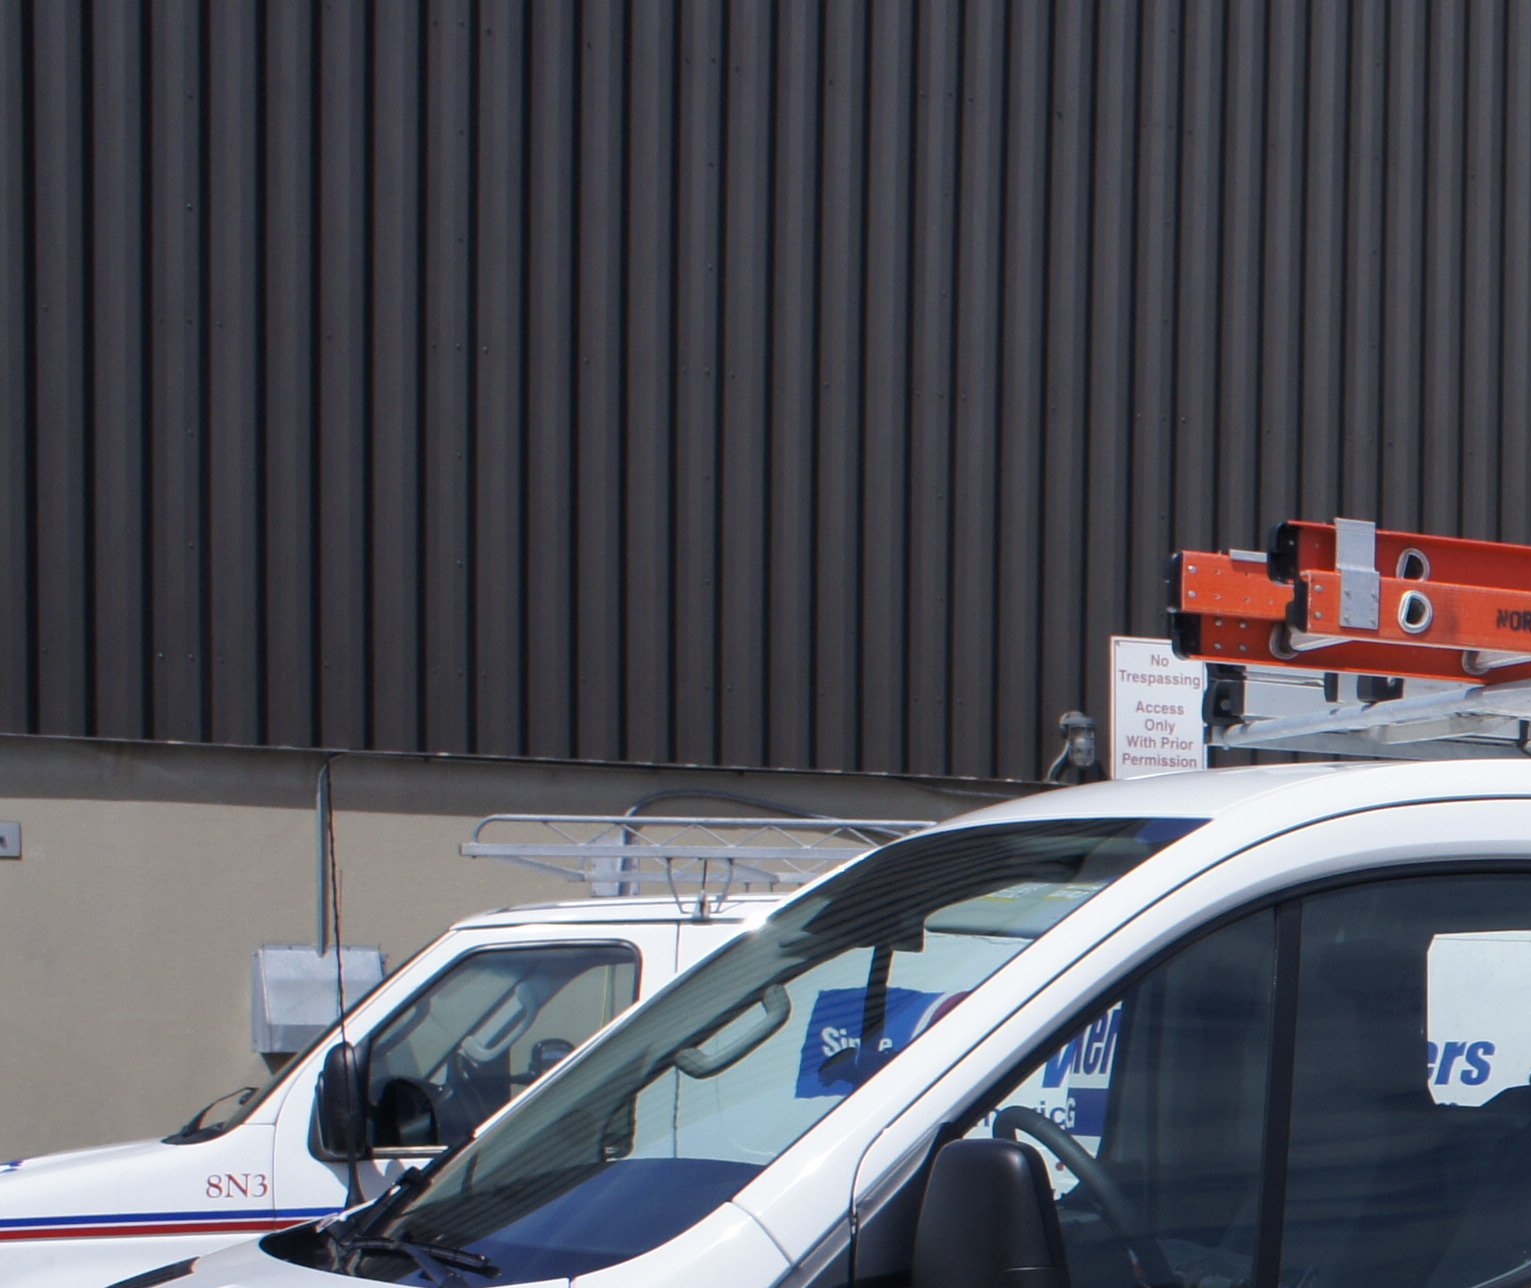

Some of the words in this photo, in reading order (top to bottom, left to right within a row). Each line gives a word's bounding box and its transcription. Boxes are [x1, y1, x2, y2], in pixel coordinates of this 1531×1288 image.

[1150, 654, 1170, 668] No
[1118, 669, 1201, 690] Trespassing
[1135, 701, 1185, 716] Access
[1144, 719, 1176, 735] Only
[1126, 736, 1158, 751] With
[1161, 737, 1194, 751] Prior
[1121, 752, 1198, 769] Permission
[821, 1026, 894, 1057] Sine
[205, 1173, 269, 1199] 8N3
